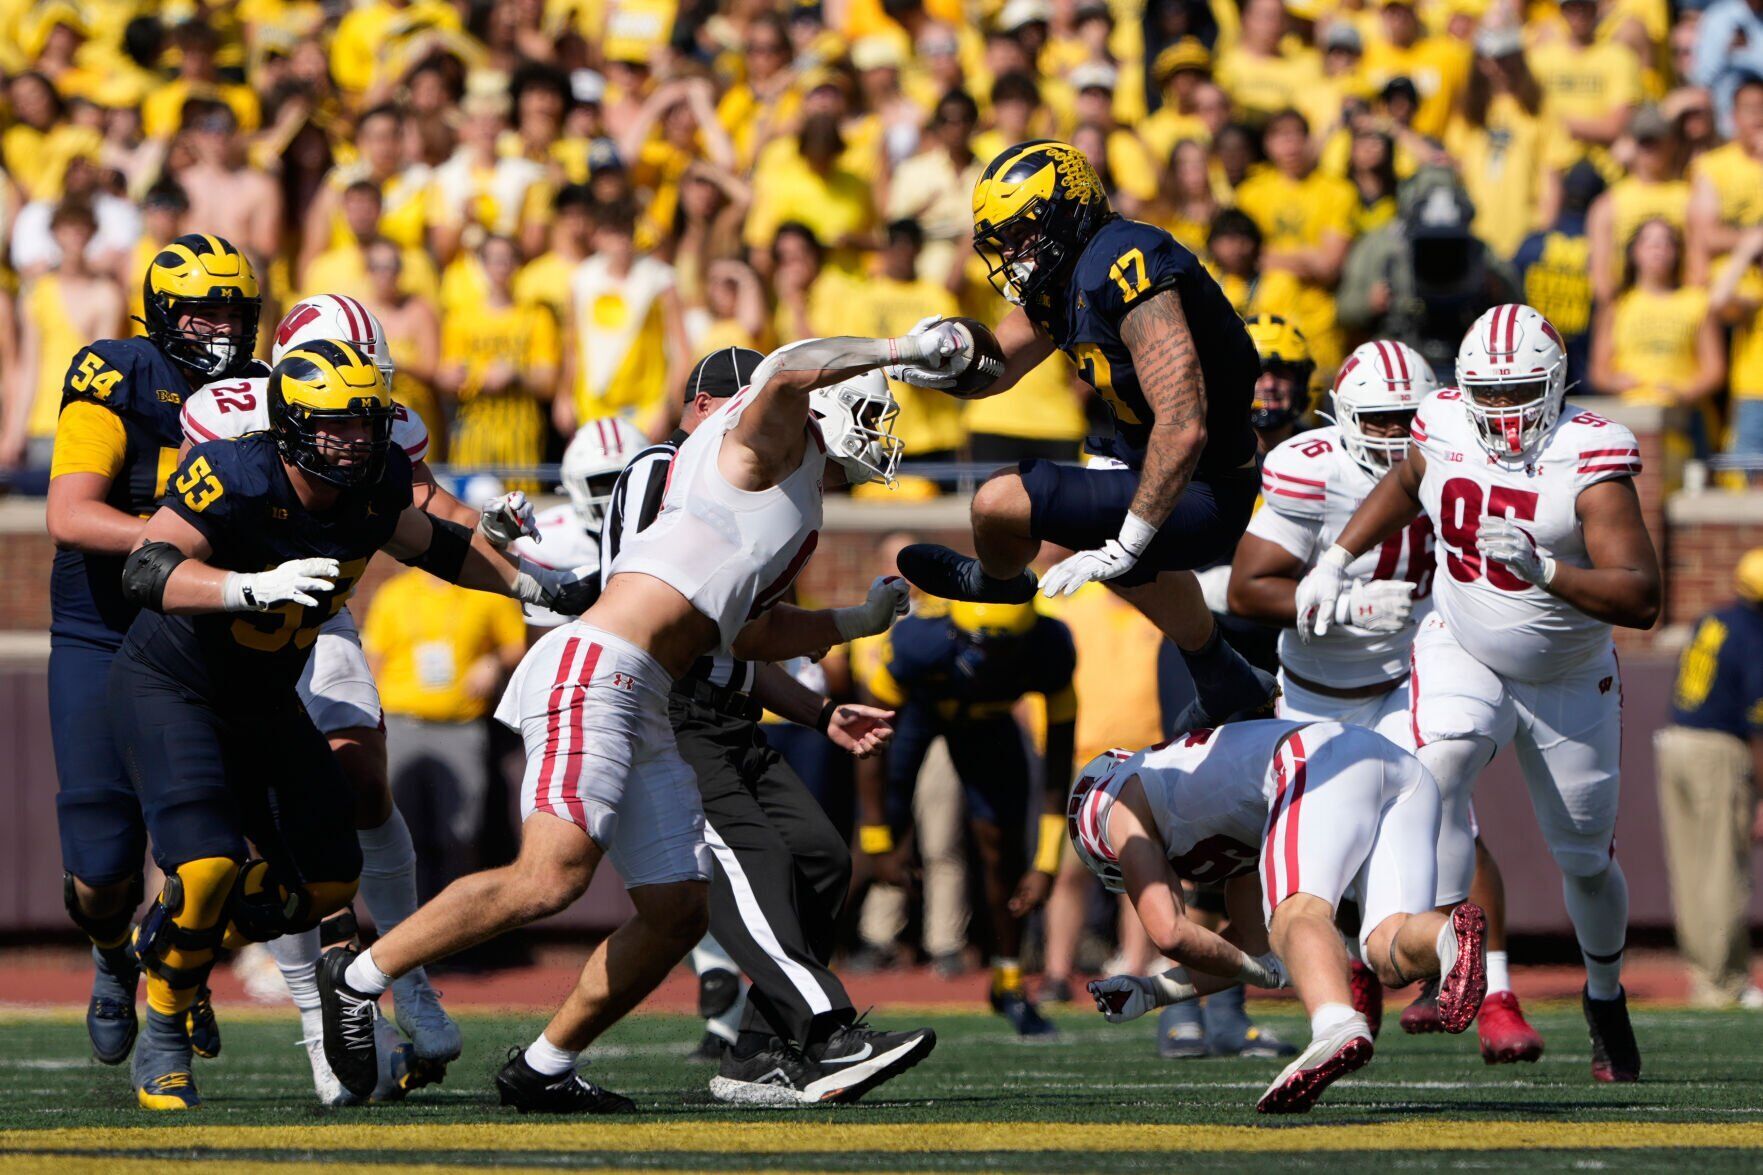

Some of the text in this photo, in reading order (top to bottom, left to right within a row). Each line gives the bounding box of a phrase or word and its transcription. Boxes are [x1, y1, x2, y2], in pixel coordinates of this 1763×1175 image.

[221, 287, 232, 297] M
[1109, 248, 1151, 303] 17
[71, 352, 123, 400] 54
[211, 381, 256, 414] 22
[362, 398, 371, 407] M
[176, 455, 223, 512] 53
[1441, 477, 1539, 591] 95
